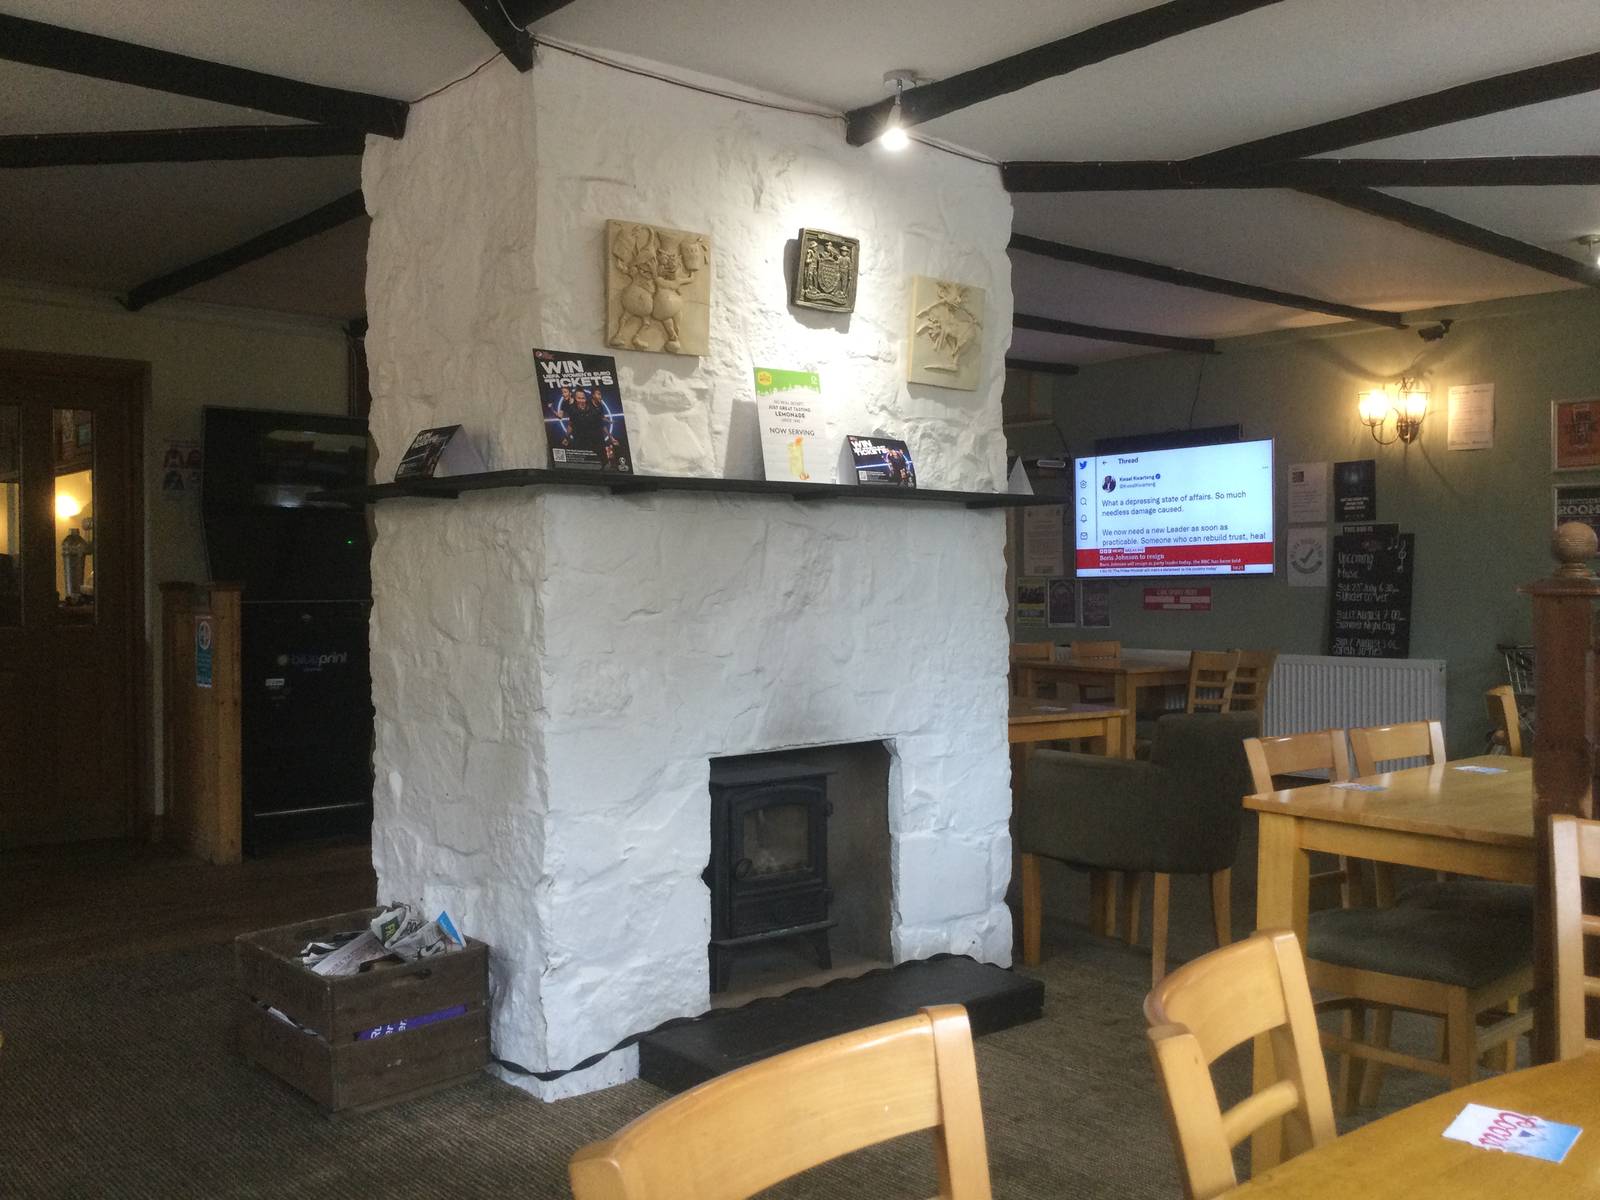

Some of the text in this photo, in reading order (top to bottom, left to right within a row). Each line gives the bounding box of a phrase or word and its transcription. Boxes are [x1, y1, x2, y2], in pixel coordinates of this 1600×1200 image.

[540, 360, 584, 374] WIN
[544, 376, 613, 389] TICKETS
[774, 411, 805, 419] LEMONADE
[788, 429, 815, 437] SERVING
[850, 440, 873, 448] WIN
[1125, 497, 1161, 505] depressing
[1180, 494, 1188, 502] of
[1189, 493, 1213, 501] affairs.
[1214, 491, 1225, 500] So
[1226, 490, 1247, 499] much
[1102, 509, 1130, 517] needless
[1131, 507, 1156, 516] damage
[1102, 538, 1138, 546] practicable.
[1141, 537, 1171, 545] Someone
[1203, 534, 1227, 542] rebuild
[1250, 532, 1266, 540] heal
[1338, 552, 1375, 571] Upcoming
